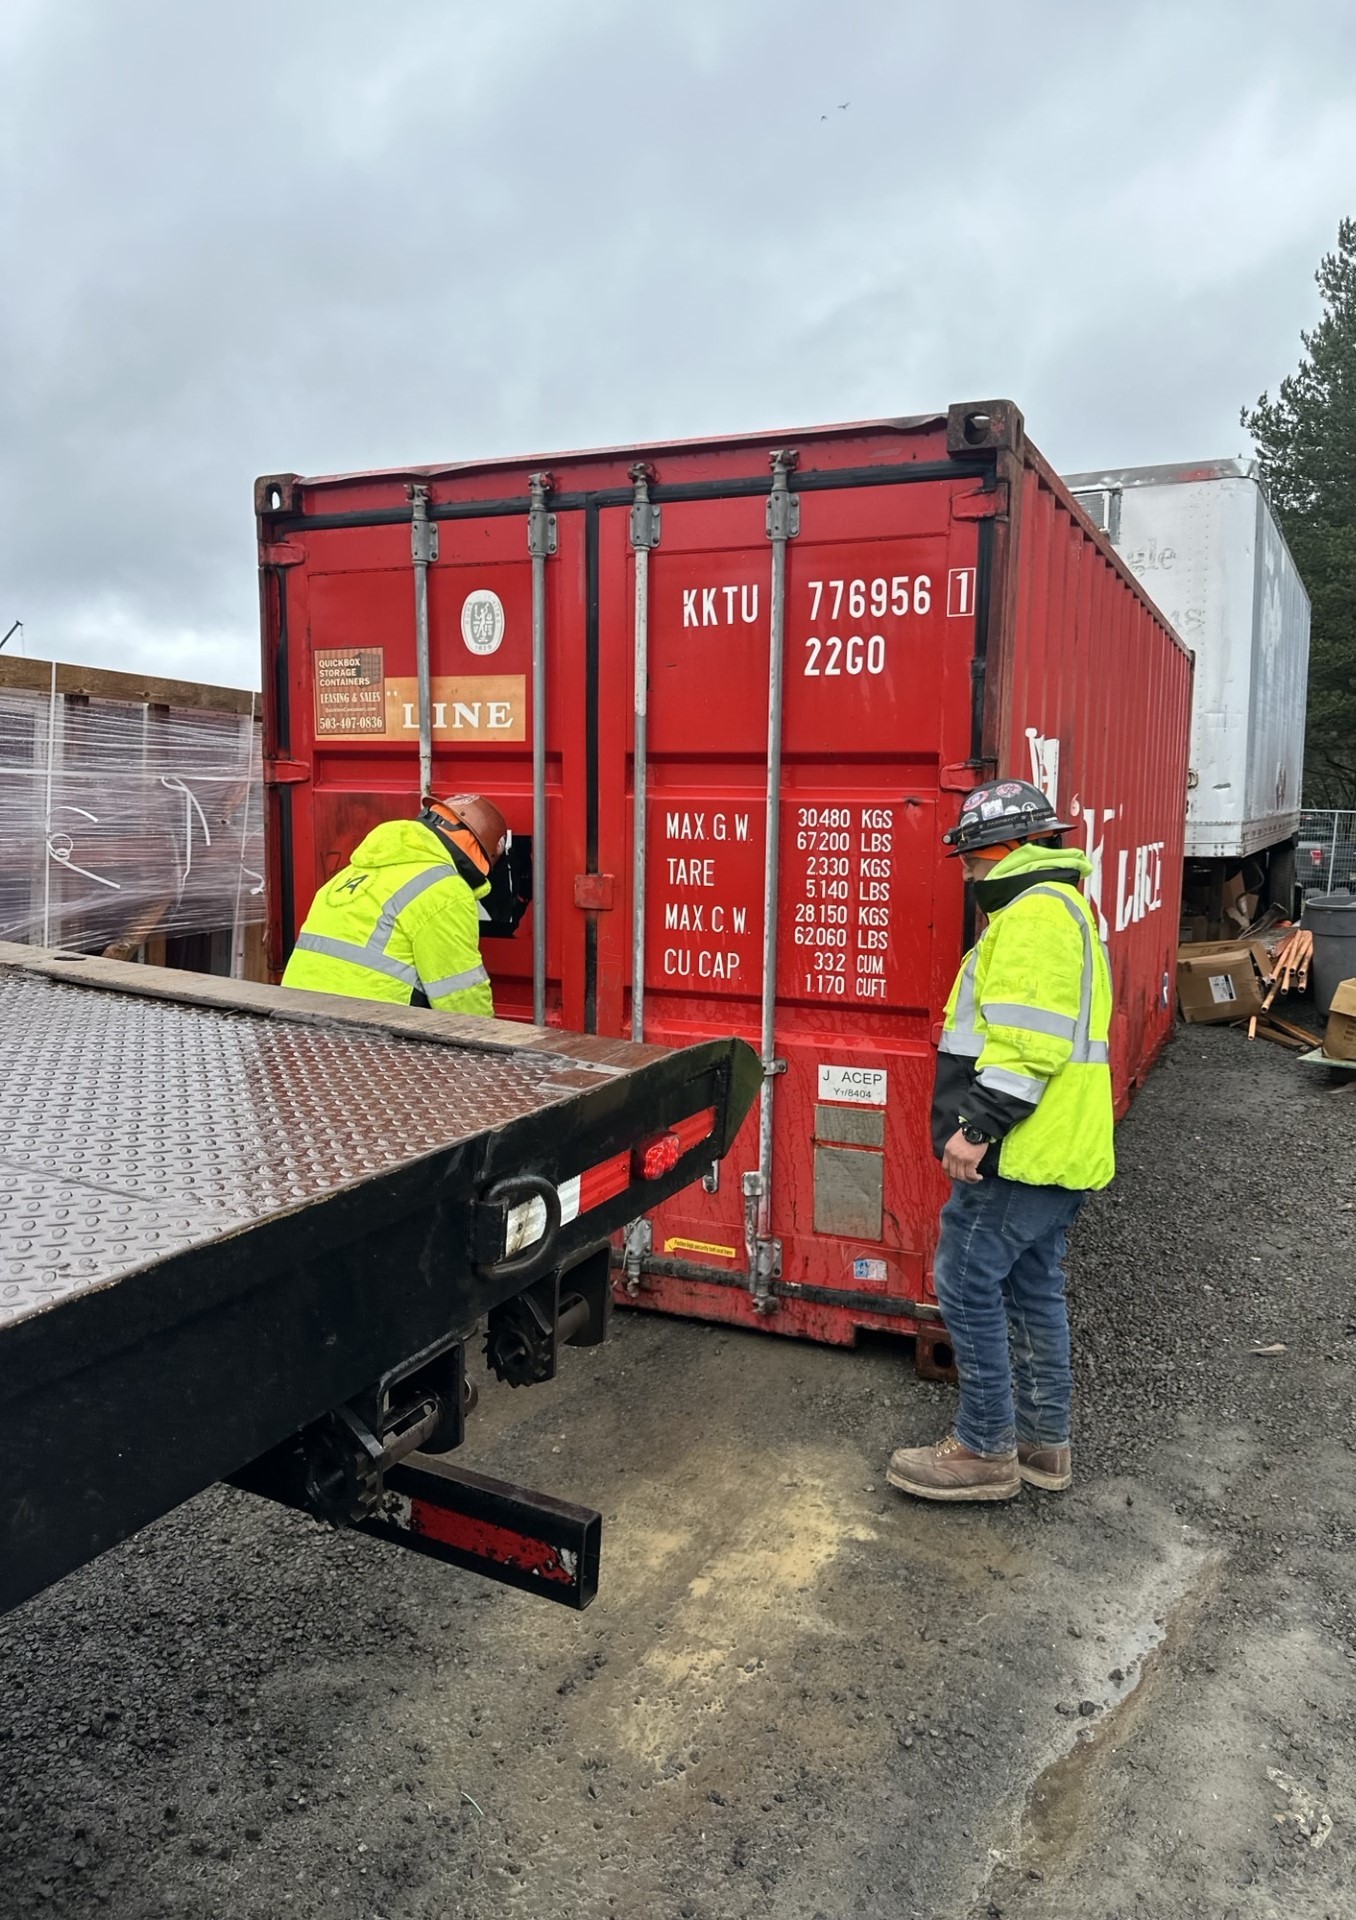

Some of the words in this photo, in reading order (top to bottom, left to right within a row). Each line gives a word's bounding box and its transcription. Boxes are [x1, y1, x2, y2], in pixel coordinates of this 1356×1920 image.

[682, 584, 759, 627] KKTU
[807, 574, 931, 620] 776956
[318, 658, 361, 668] QUICKBOX
[318, 668, 357, 678] STORAGE
[319, 677, 371, 687] CONTAINERS
[320, 693, 350, 704] LEASING
[351, 693, 358, 703] &
[360, 691, 381, 703] SALES
[319, 715, 383, 730] 503-407-0836
[402, 702, 514, 728] LINE
[797, 808, 851, 828] 30.480
[861, 809, 893, 829] KGS
[796, 831, 850, 852] 67.200
[860, 833, 892, 853] LBS
[667, 858, 715, 887] TARE
[806, 856, 849, 876] 2.330
[859, 858, 891, 878] KGS
[805, 880, 848, 900] 5.140
[859, 881, 890, 901] LBS
[794, 903, 848, 924] 28.150
[858, 906, 889, 927] KGS
[794, 926, 847, 948] 62.060
[857, 930, 888, 950] LBS
[813, 951, 846, 972] 33.2
[805, 973, 845, 995] 1.170
[823, 1070, 830, 1081] J
[841, 1071, 883, 1085] ACEP
